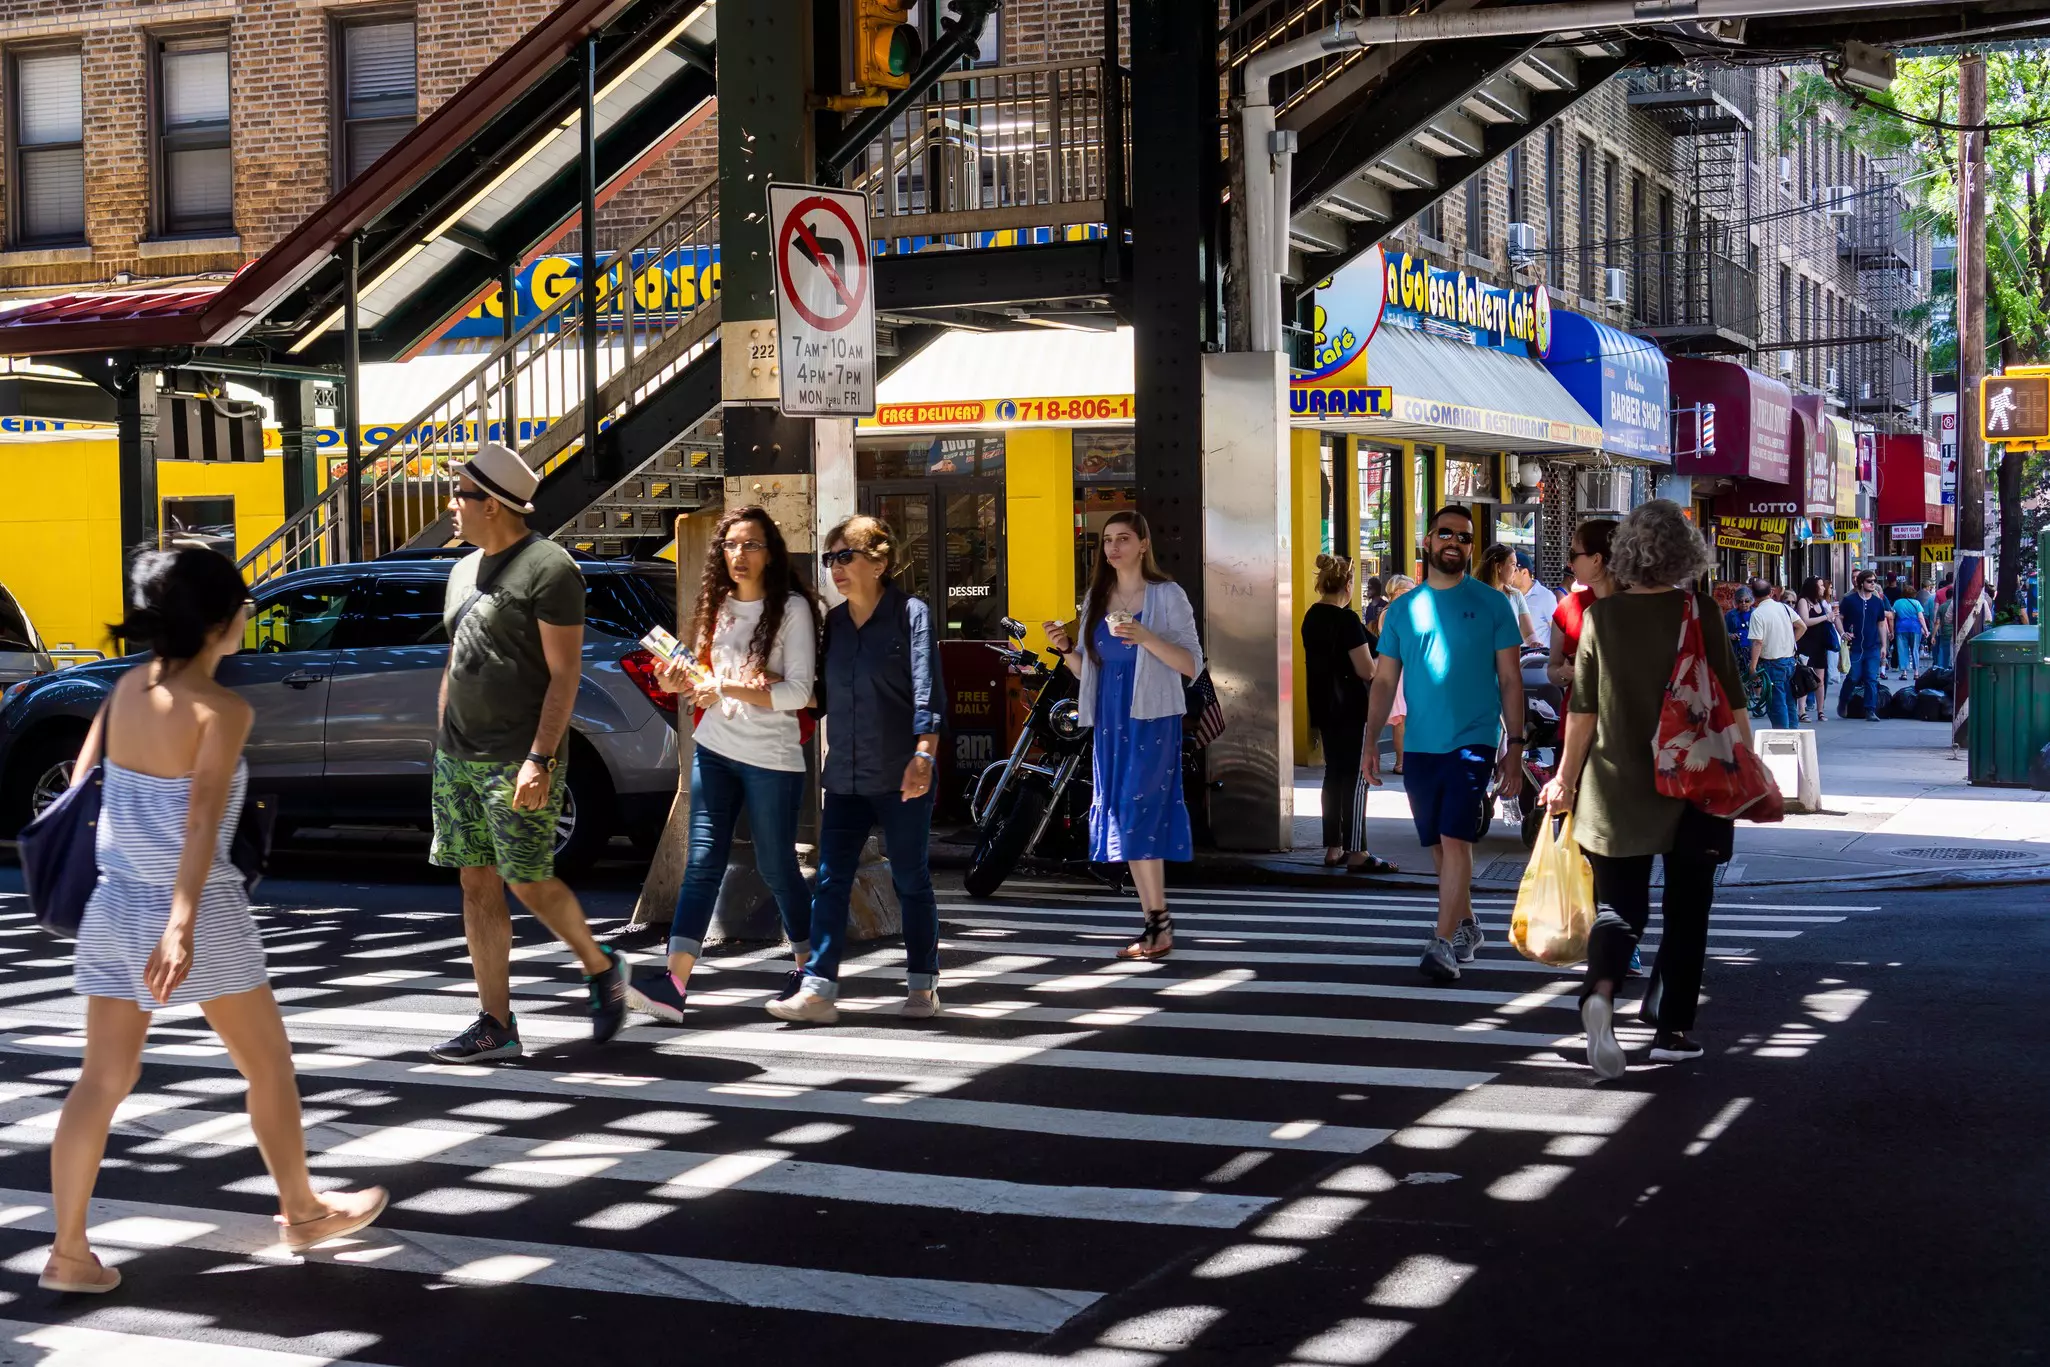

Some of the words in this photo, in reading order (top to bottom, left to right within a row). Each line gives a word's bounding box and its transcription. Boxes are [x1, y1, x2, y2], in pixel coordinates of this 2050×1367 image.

[1401, 252, 1457, 321] Golosa
[1457, 271, 1507, 346] Bakery
[1508, 288, 1535, 342] Café
[799, 390, 822, 405] MON
[826, 396, 840, 405] THRU
[844, 391, 860, 405] FRI
[882, 408, 914, 424] FREE
[917, 405, 981, 422] DELIVERY
[1018, 398, 1135, 421] 718-806-1
[1404, 400, 1482, 429] COLOMBIAN
[1485, 413, 1549, 439] RESTAURANT
[1610, 390, 1641, 427] BARBER
[1641, 400, 1661, 432] SHOP
[1749, 502, 1797, 513] LOTTO
[1720, 517, 1736, 527] WE
[1738, 517, 1758, 530] BUY
[1760, 518, 1787, 534] GOLD
[1719, 536, 1765, 551] COMPRAMOS
[1765, 543, 1780, 553] ORO
[948, 586, 990, 597] DESSERT
[957, 691, 988, 702] FREE
[955, 703, 991, 714] DAILY
[956, 734, 993, 759] am
